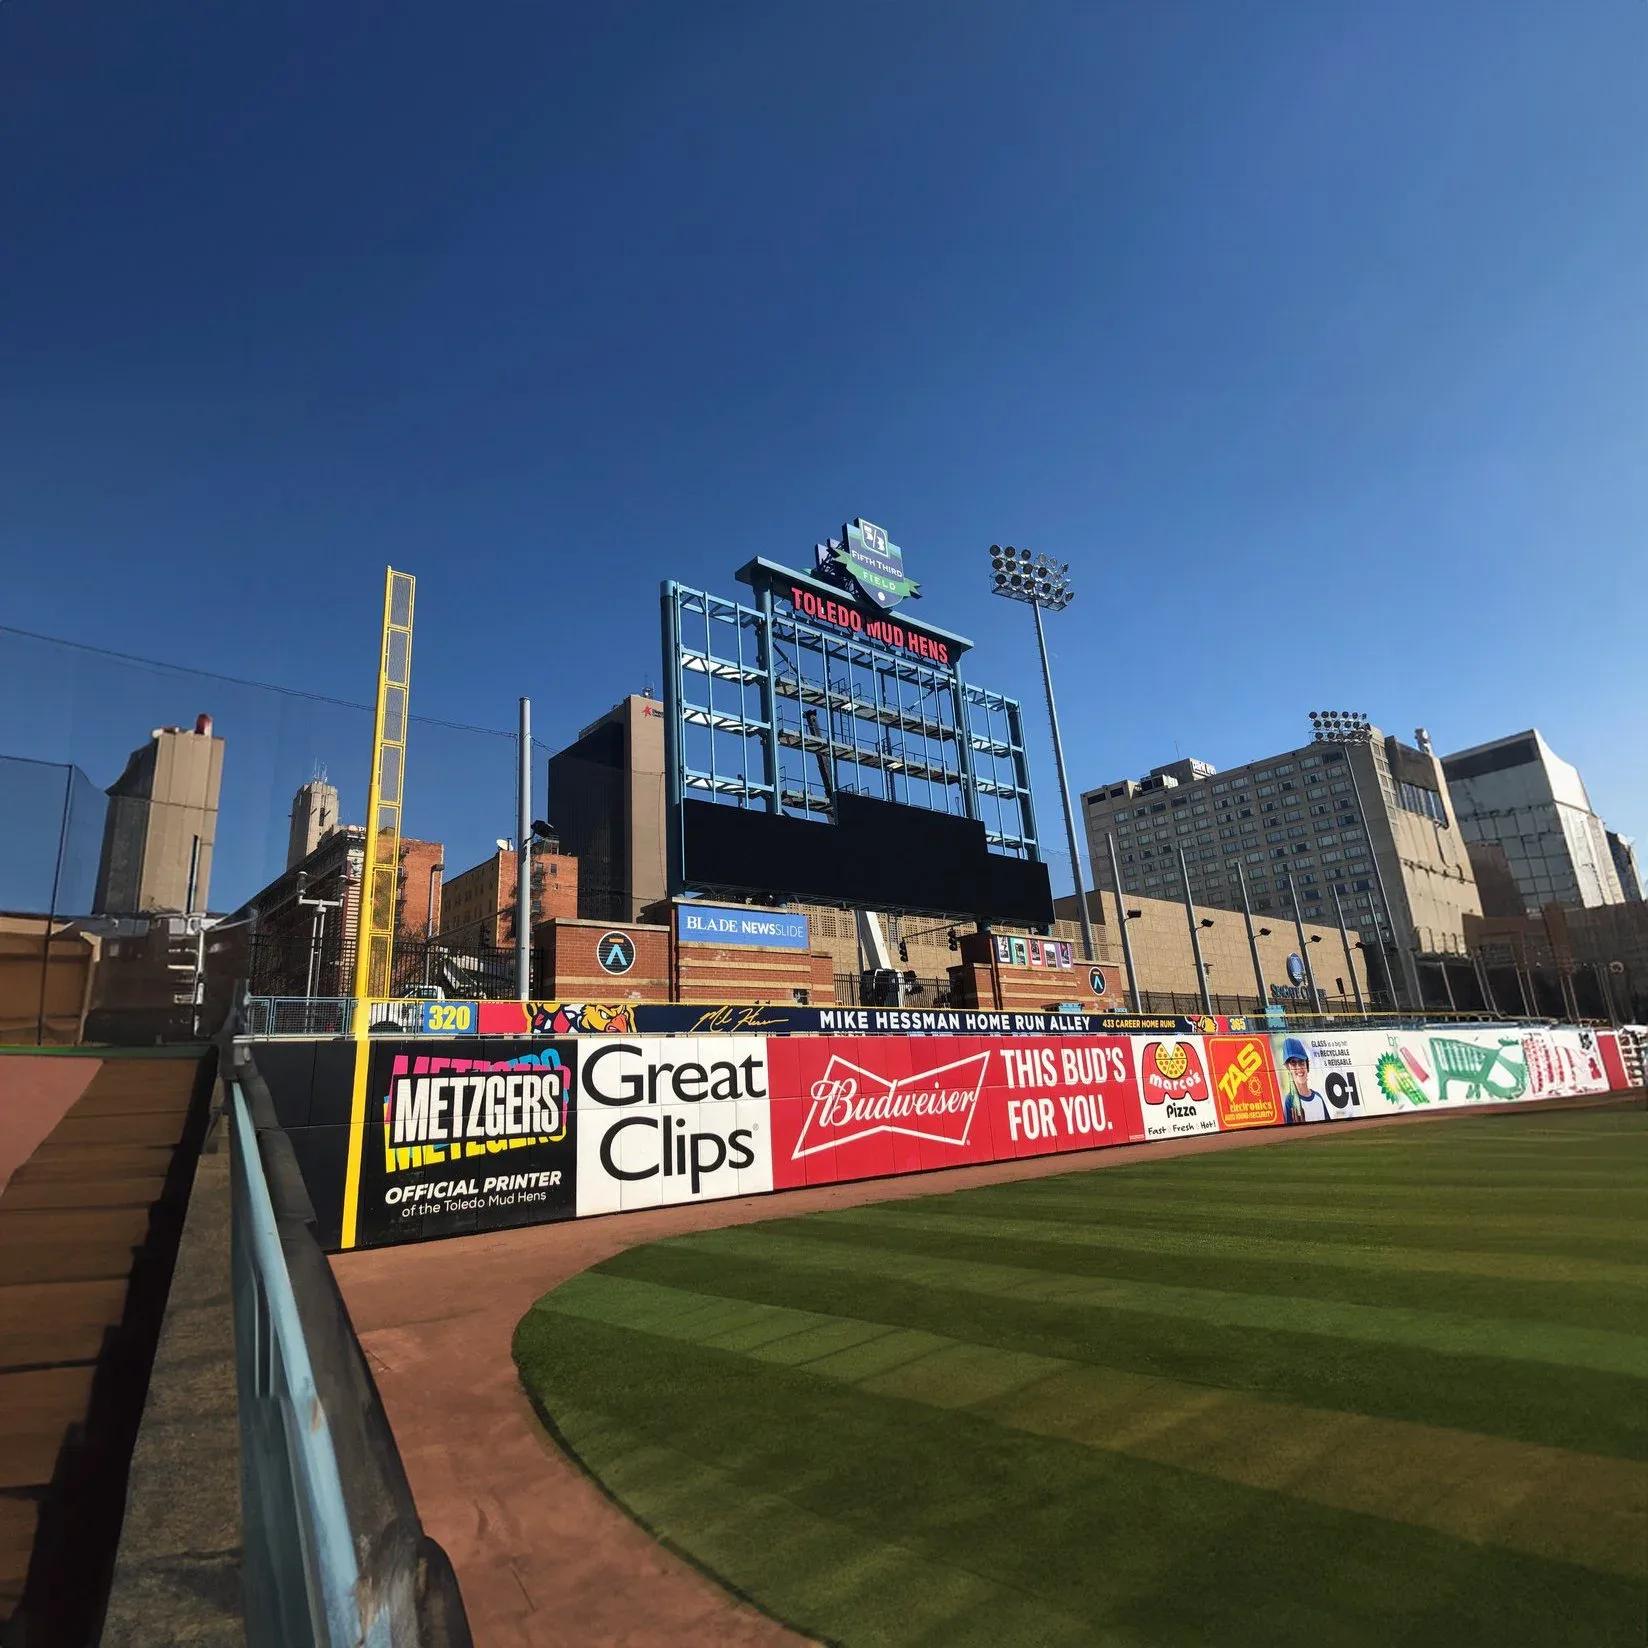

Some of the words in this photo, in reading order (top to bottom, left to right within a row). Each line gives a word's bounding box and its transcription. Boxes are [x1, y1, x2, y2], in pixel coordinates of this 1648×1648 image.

[851, 550, 876, 566] FIFTH
[876, 560, 903, 578] THIRD
[863, 571, 896, 590] FIELD
[791, 587, 862, 632] TOLEDO
[866, 617, 904, 647] MUD
[907, 631, 949, 664] HENS
[687, 915, 738, 933] BLADE
[428, 1005, 471, 1030] 320
[819, 1010, 868, 1029] MIKE
[875, 1011, 960, 1030] HESSMAN
[966, 1013, 1010, 1030] HOME
[1015, 1015, 1048, 1031] RUN
[1050, 1016, 1090, 1031] ALLEY
[1102, 1019, 1115, 1029] 433
[1115, 1019, 1140, 1029] CAREER
[1141, 1020, 1159, 1029] HOME
[1160, 1020, 1176, 1029] RUNS
[1311, 1040, 1327, 1048] GLASS
[1320, 1049, 1350, 1057] RECYCLABLE
[581, 1043, 767, 1106] Great
[1000, 1048, 1058, 1089] THIS
[1060, 1046, 1127, 1085] BUD'S
[1218, 1042, 1263, 1102] TAS
[1327, 1058, 1352, 1067] REUSABLE
[394, 1073, 560, 1143] METZGERS
[810, 1078, 977, 1128] Budweiser
[1166, 1102, 1197, 1118] Pizza
[1007, 1098, 1058, 1141] FOR
[1059, 1094, 1113, 1135] YOU.
[1148, 1126, 1166, 1136] Fast
[1172, 1123, 1194, 1132] Fresh
[1200, 1120, 1216, 1129] Hot!
[600, 1115, 755, 1194] Clips
[385, 1178, 479, 1205] OFFICIAL
[483, 1170, 562, 1194] PRINTER
[402, 1204, 416, 1218] of
[419, 1201, 440, 1215] the
[444, 1196, 485, 1212] Toledo
[489, 1193, 515, 1207] Mud
[517, 1190, 547, 1203] Hens
